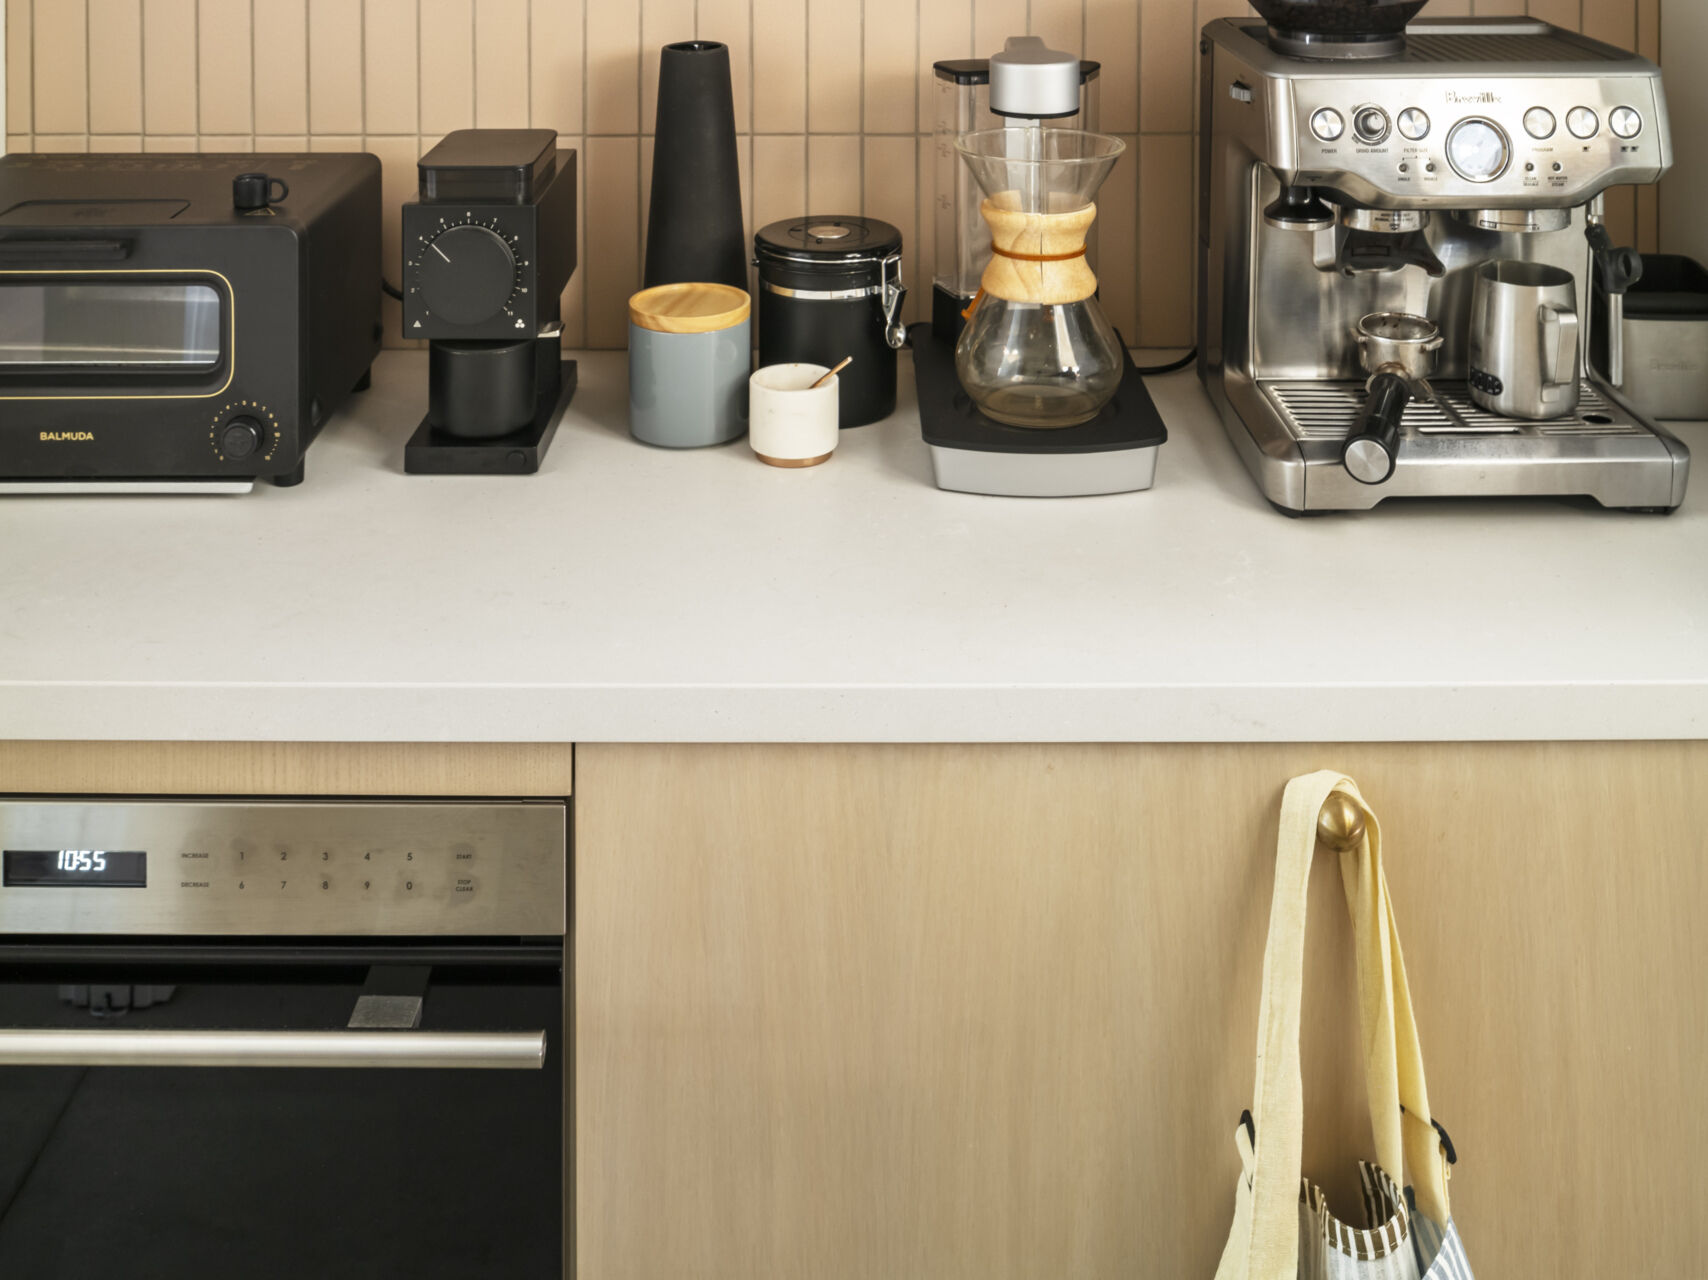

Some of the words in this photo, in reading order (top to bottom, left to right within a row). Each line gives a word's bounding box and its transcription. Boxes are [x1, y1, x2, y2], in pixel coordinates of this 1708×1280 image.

[40, 431, 95, 441] BALMUDA
[57, 850, 106, 871] 10:55
[240, 852, 244, 860] 1
[280, 852, 287, 860] 2
[322, 852, 329, 861] 3
[364, 852, 370, 861] 4
[407, 852, 413, 861] 5
[239, 881, 245, 889] 6
[281, 881, 287, 889] 7
[322, 881, 329, 890] 8
[364, 881, 370, 890] 9
[406, 881, 413, 890] 0
